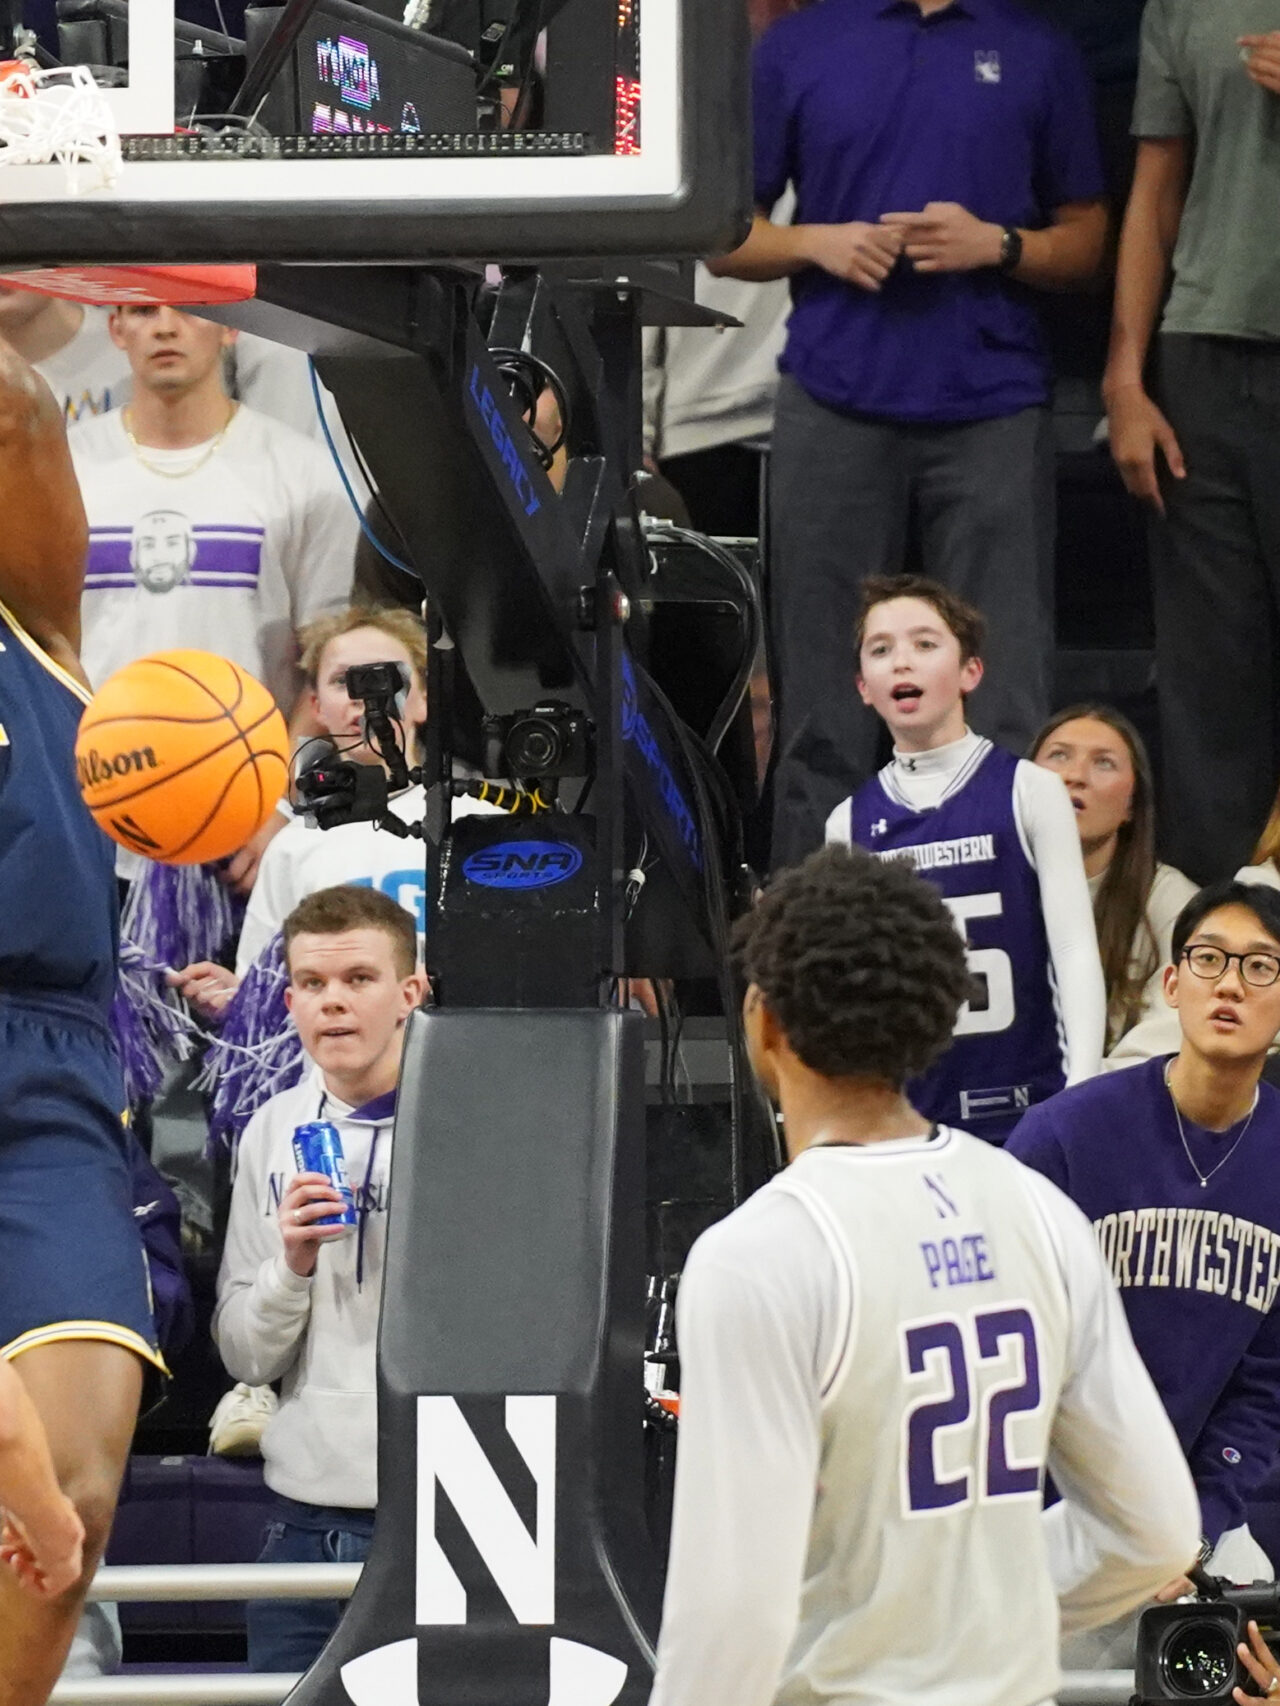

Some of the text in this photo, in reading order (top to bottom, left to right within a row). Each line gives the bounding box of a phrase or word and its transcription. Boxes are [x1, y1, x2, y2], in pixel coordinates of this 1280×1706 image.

[77, 746, 158, 790] ilson
[466, 852, 571, 872] SNA
[920, 1233, 996, 1289] PAGE
[1094, 1207, 1280, 1315] ORTHWESTER
[898, 1298, 1044, 1520] 22
[415, 1394, 557, 1625] N
